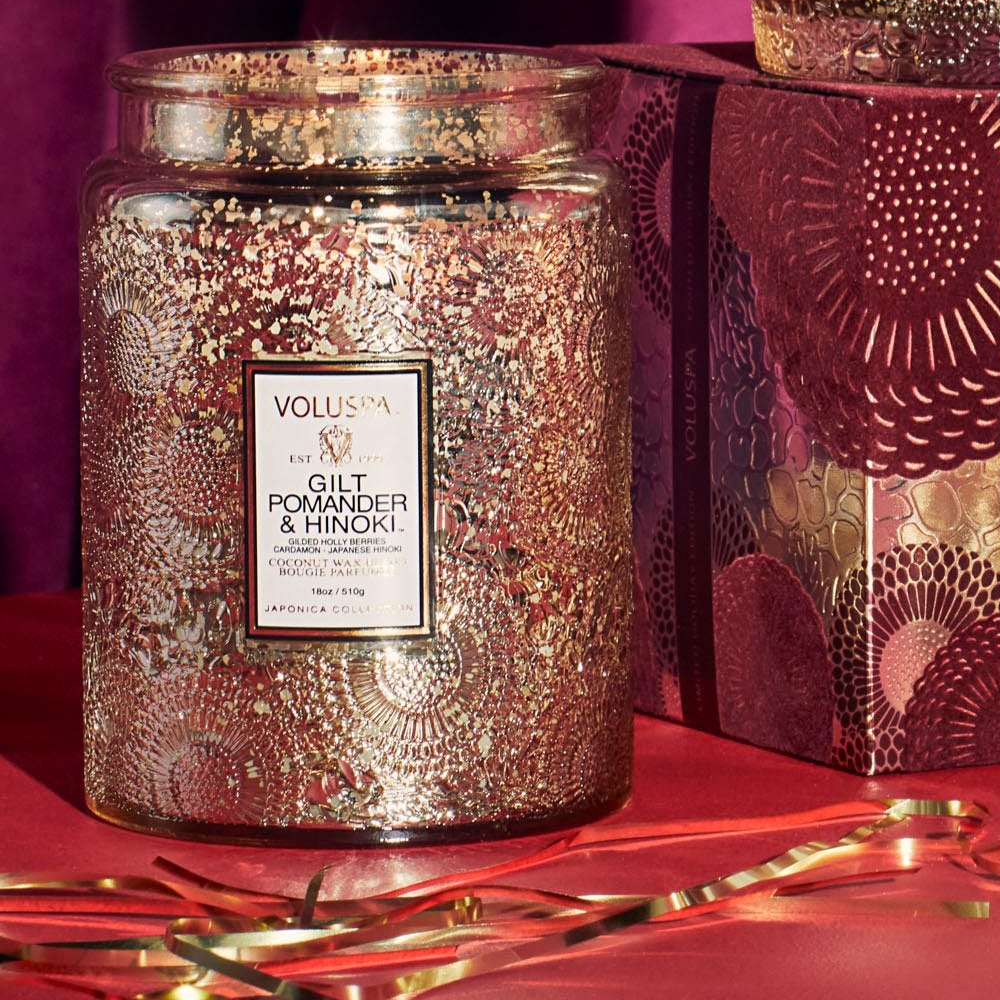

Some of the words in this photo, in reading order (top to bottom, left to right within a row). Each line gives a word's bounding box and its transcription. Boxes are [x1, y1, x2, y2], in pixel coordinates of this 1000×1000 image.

[274, 395, 391, 418] VOLUSPA
[684, 346, 697, 463] VOLUSPA
[308, 474, 367, 493] GILT
[269, 493, 407, 513] POMANDER
[280, 515, 296, 534] &
[305, 515, 395, 534] HINOKI
[273, 546, 321, 554] CARDAMON
[328, 546, 371, 554] JAPANESE
[373, 545, 402, 553] HINOKI
[268, 558, 328, 567] COCONUT
[333, 558, 361, 567] WAX
[279, 568, 326, 576] BOUGIE
[311, 588, 333, 596] 18oz
[341, 588, 365, 597] 510g
[265, 604, 326, 613] JAPONICA
